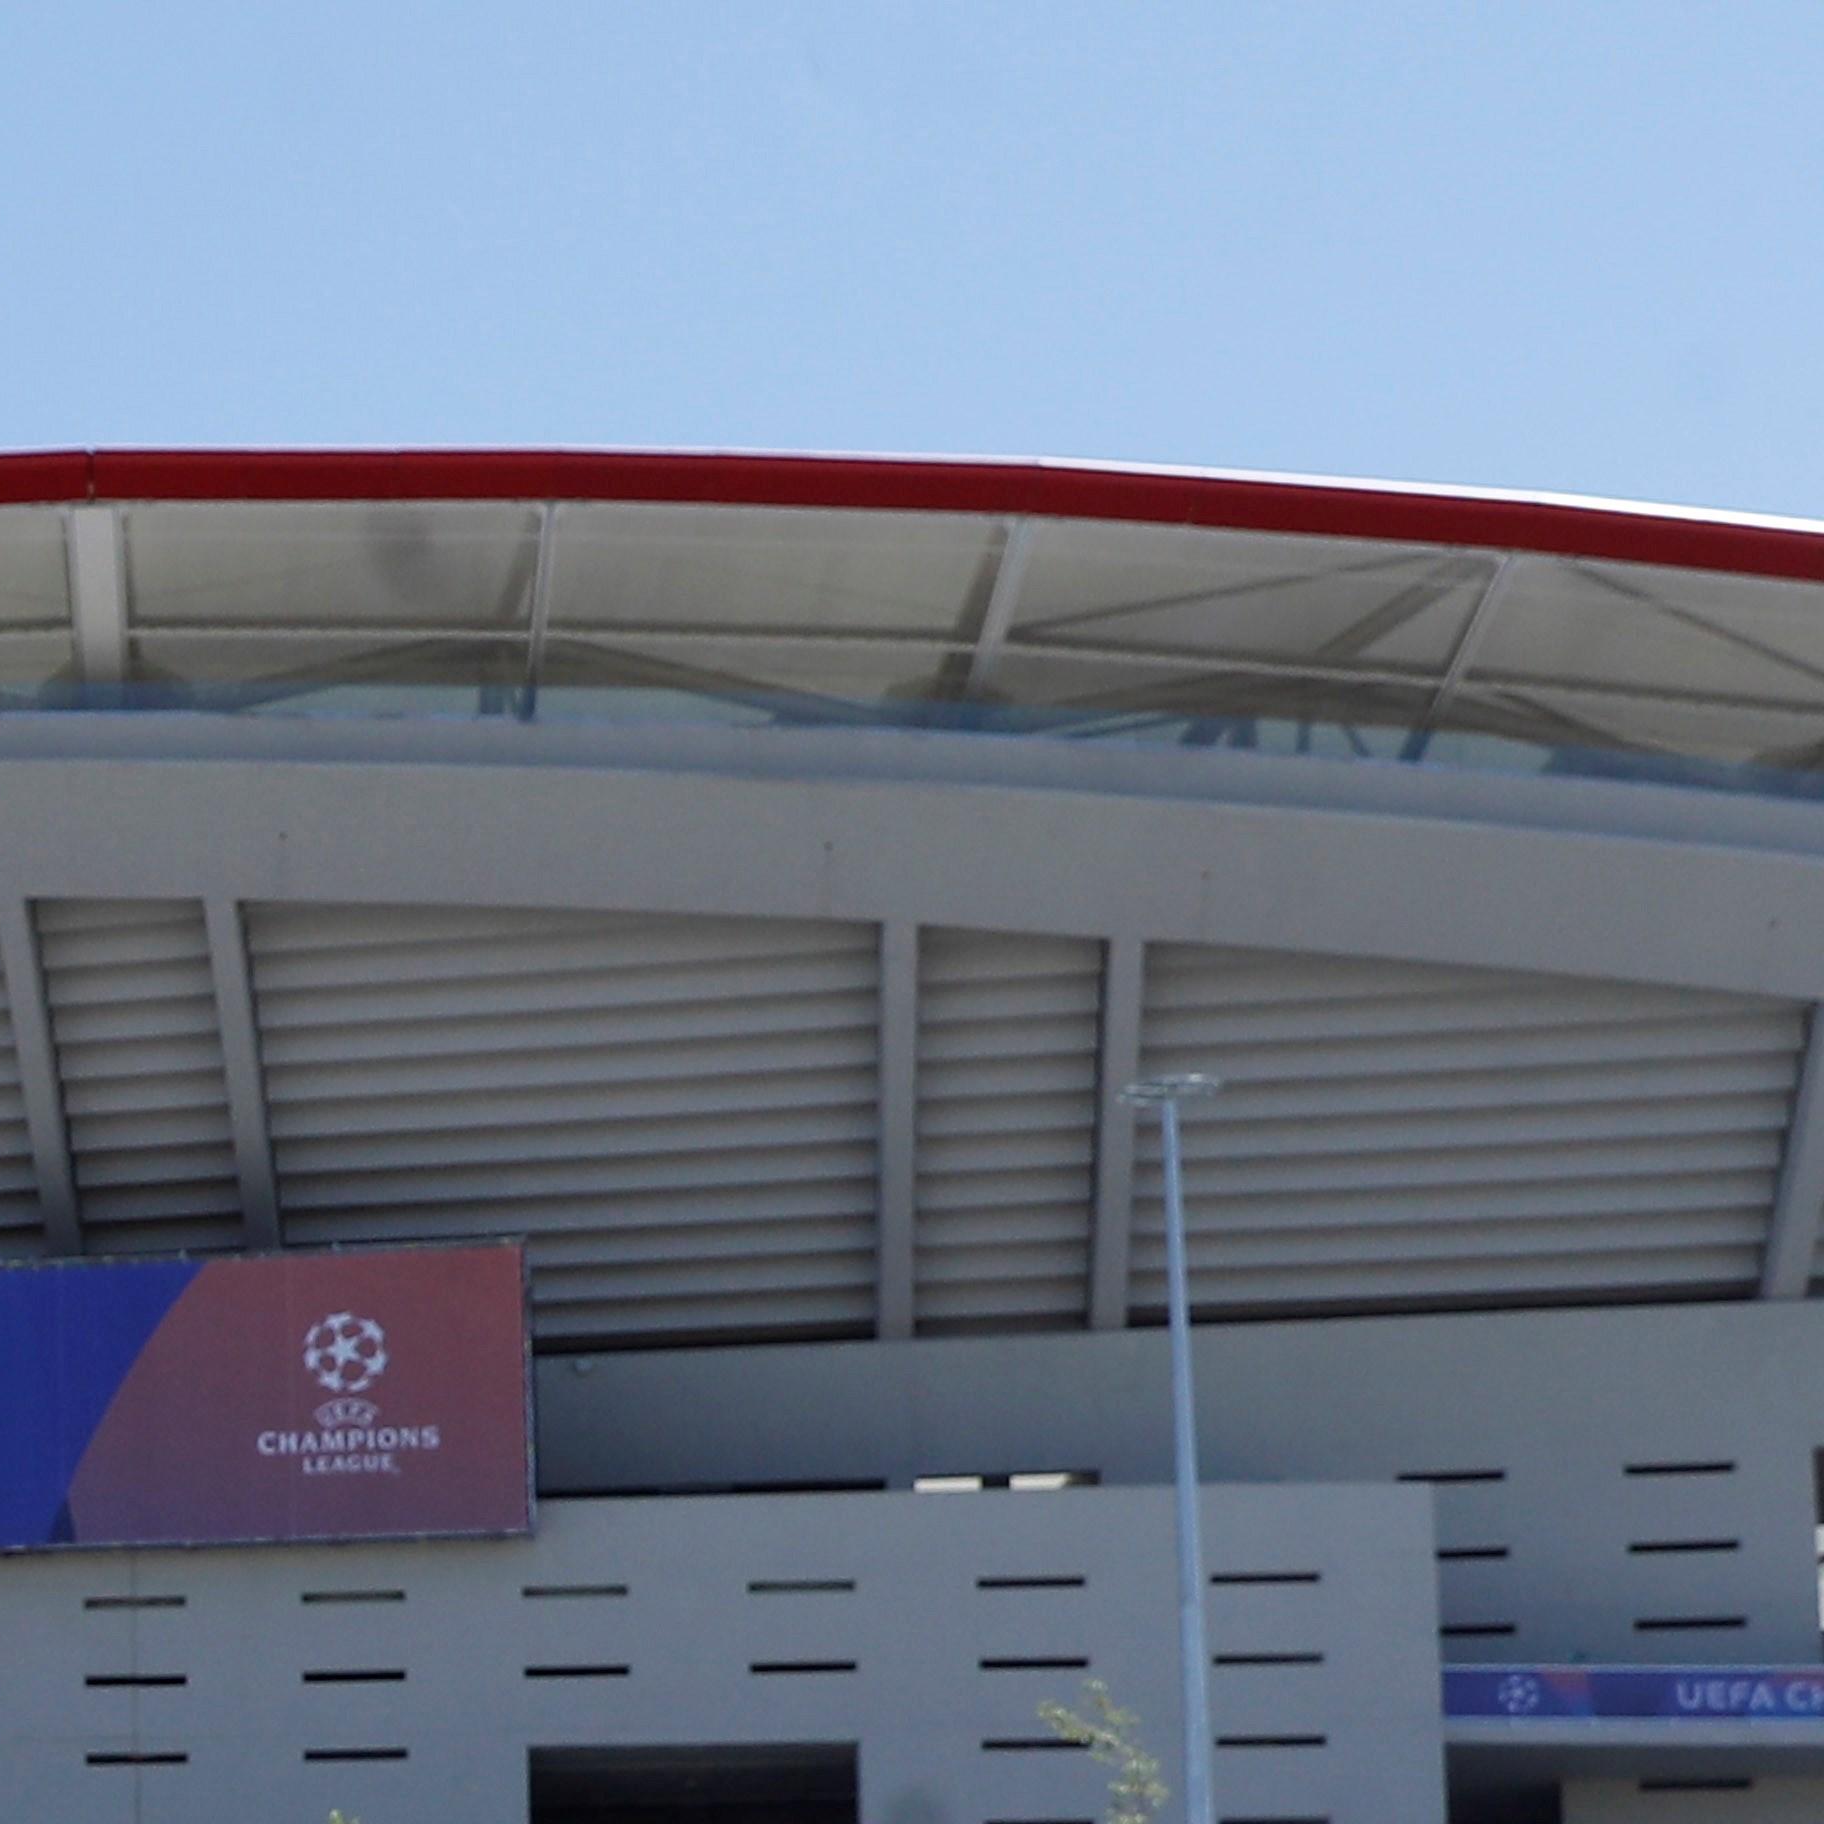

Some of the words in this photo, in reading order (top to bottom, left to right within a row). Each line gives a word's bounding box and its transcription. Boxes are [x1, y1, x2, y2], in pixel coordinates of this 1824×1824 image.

[256, 1425, 441, 1456] CHAMPIONS
[303, 1453, 395, 1475] LEAGUE
[1676, 1680, 1776, 1711] UEFA
